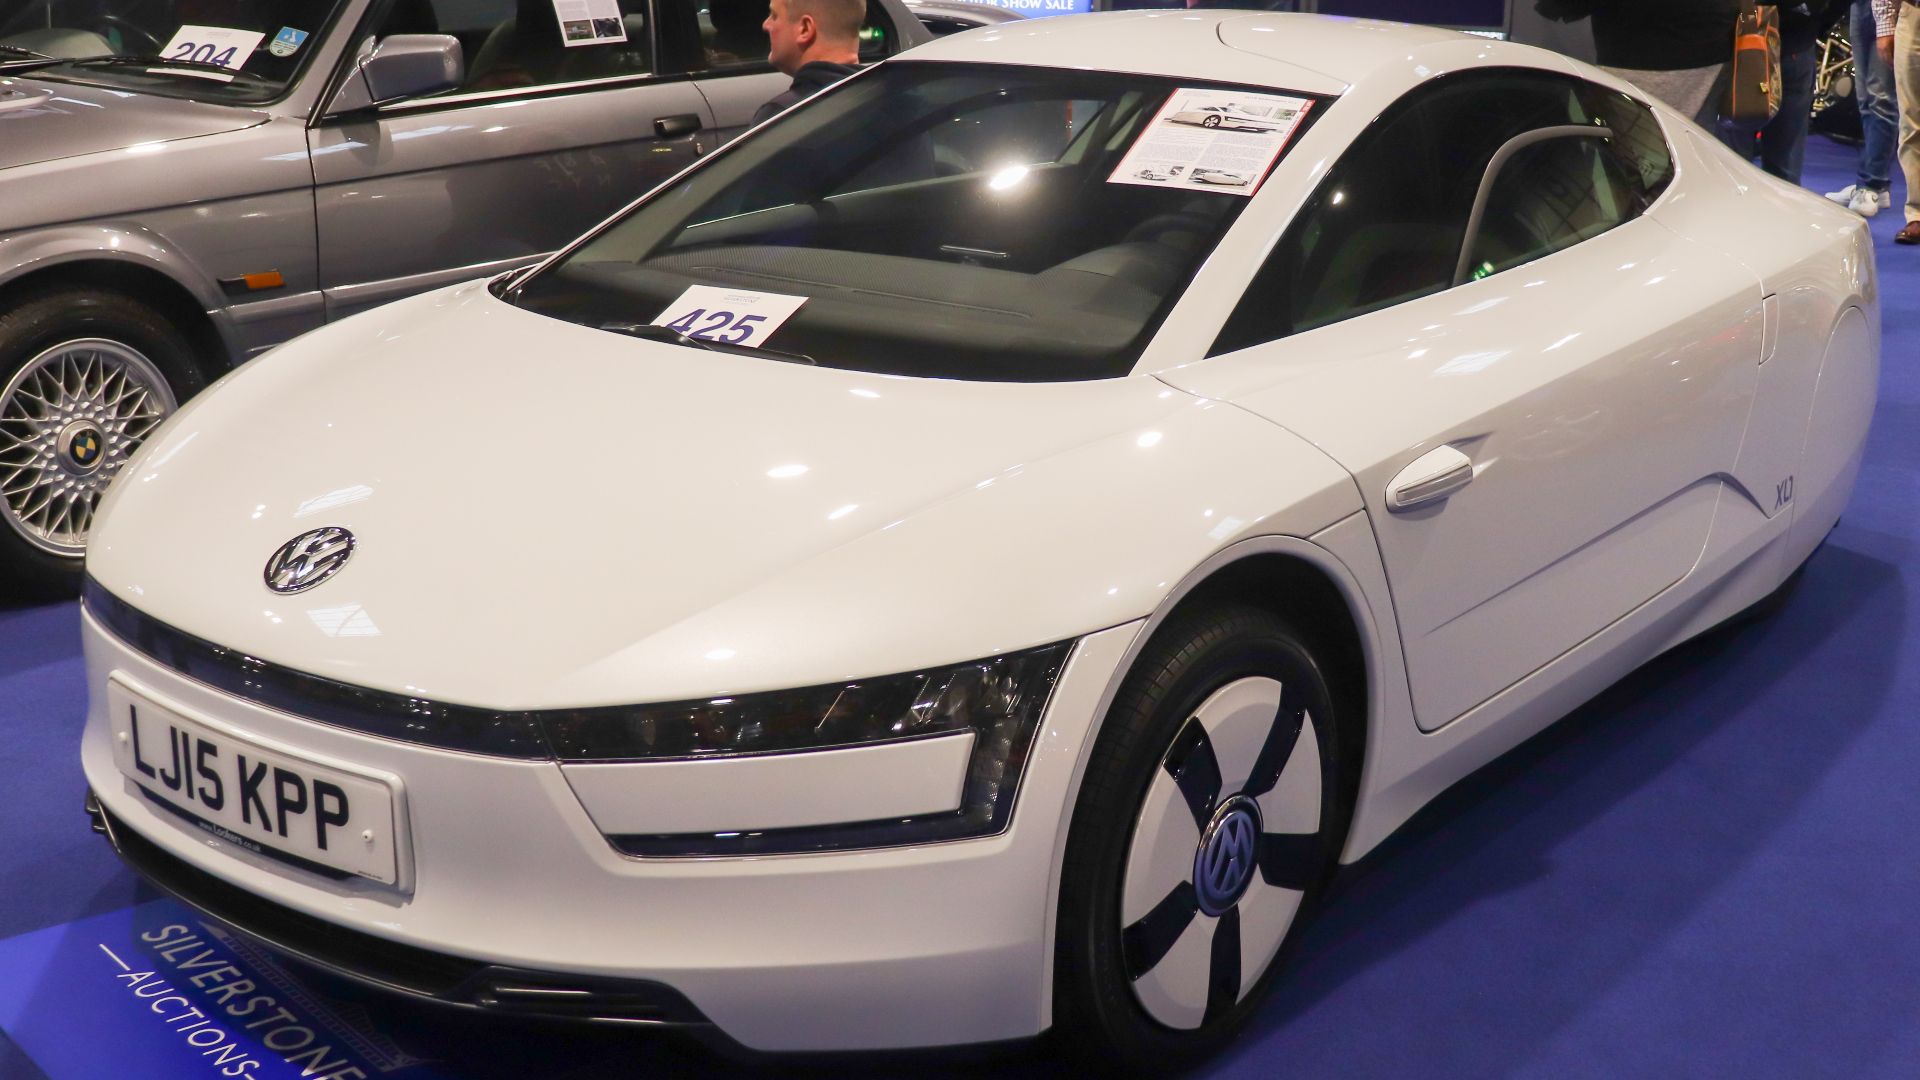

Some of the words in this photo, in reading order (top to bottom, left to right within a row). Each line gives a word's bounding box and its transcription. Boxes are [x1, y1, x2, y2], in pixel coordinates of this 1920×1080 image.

[1001, 0, 1042, 9] SHOW
[1045, 0, 1074, 10] SALE
[168, 42, 238, 68] 204
[666, 309, 768, 344] 425
[130, 704, 224, 811] LJ15
[238, 754, 349, 850] KPP
